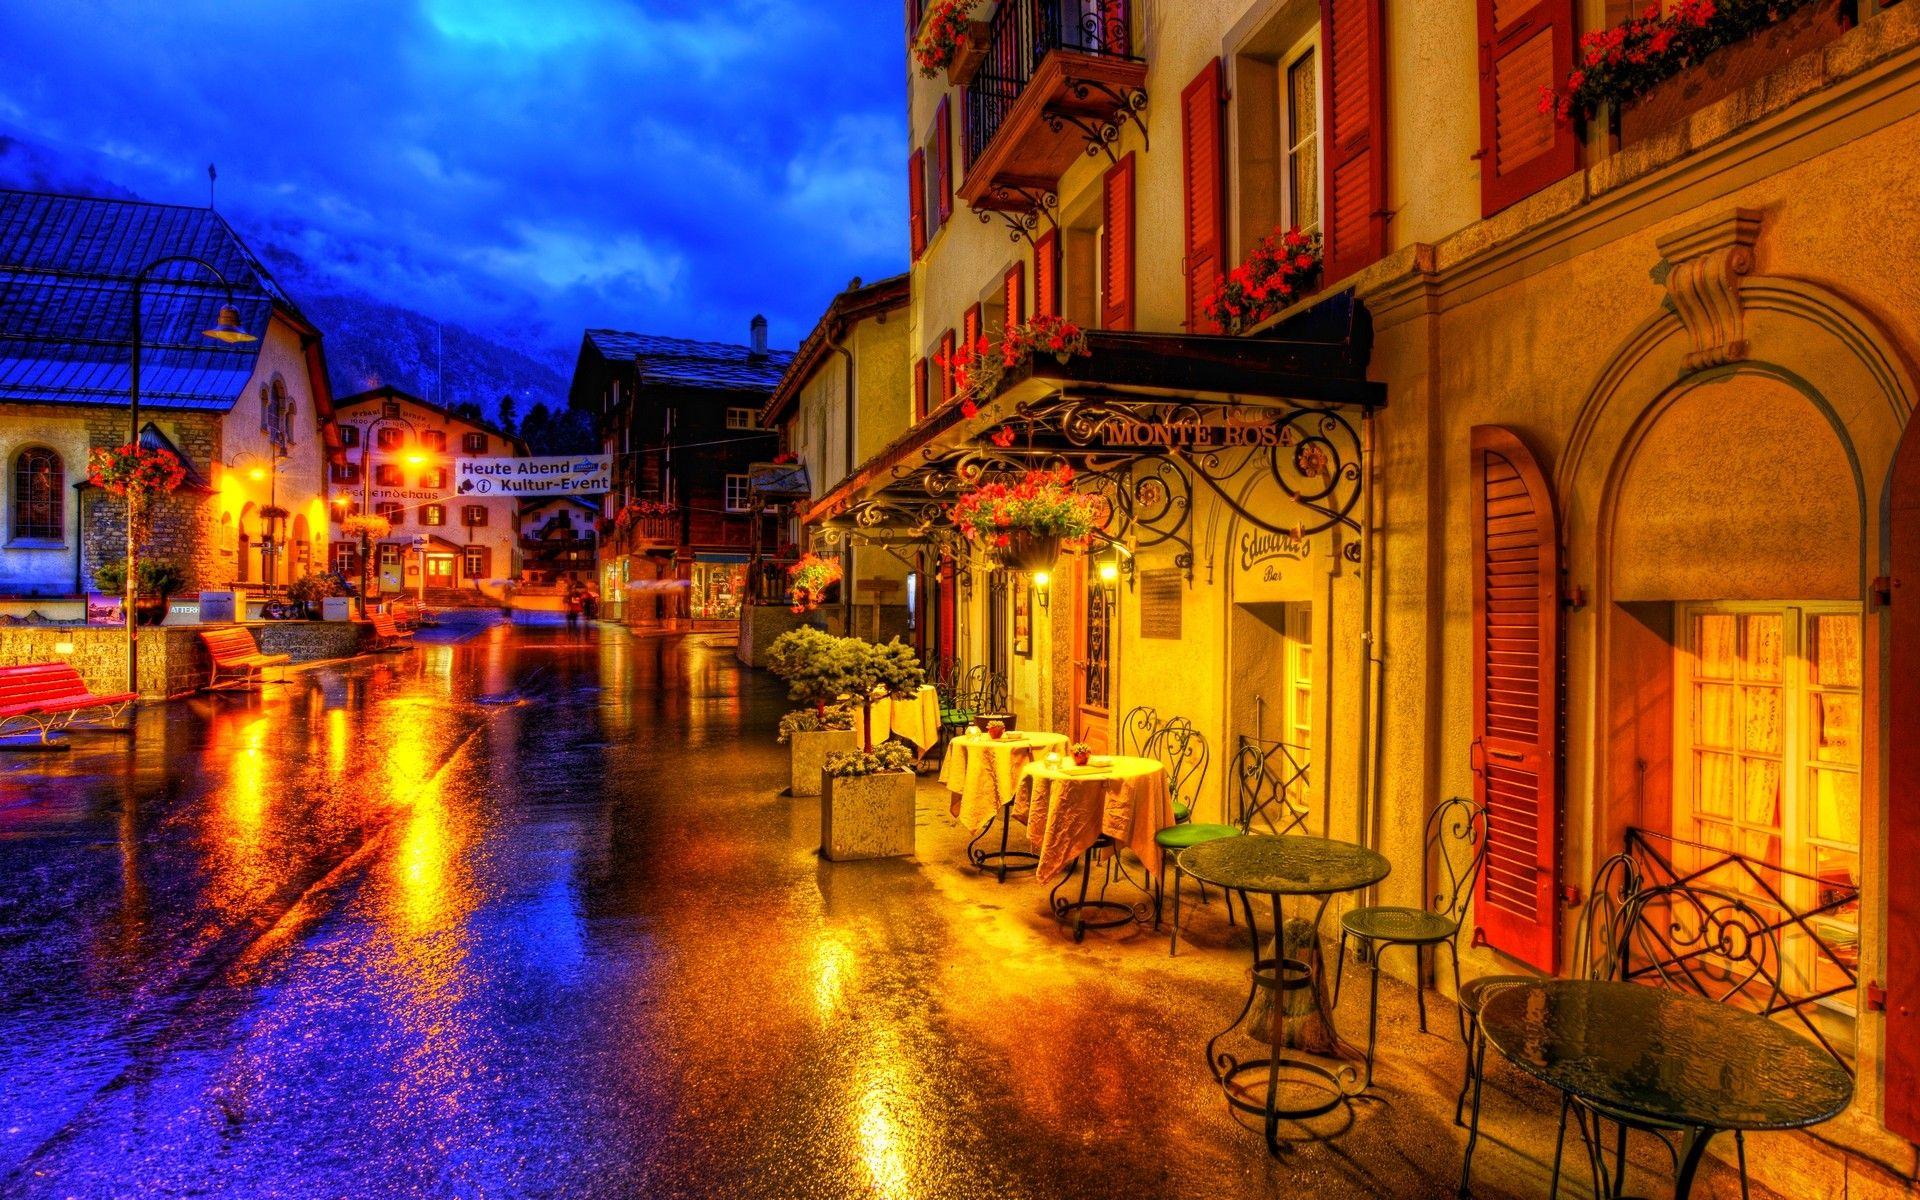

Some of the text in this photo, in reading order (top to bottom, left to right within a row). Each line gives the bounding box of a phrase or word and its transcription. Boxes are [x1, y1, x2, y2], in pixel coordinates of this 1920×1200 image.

[1107, 422, 1295, 446] MONTE ROSA
[462, 462, 511, 475] Heute
[518, 461, 570, 475] Abend
[501, 476, 609, 491] Kultur-Event
[1263, 564, 1282, 582] Bar
